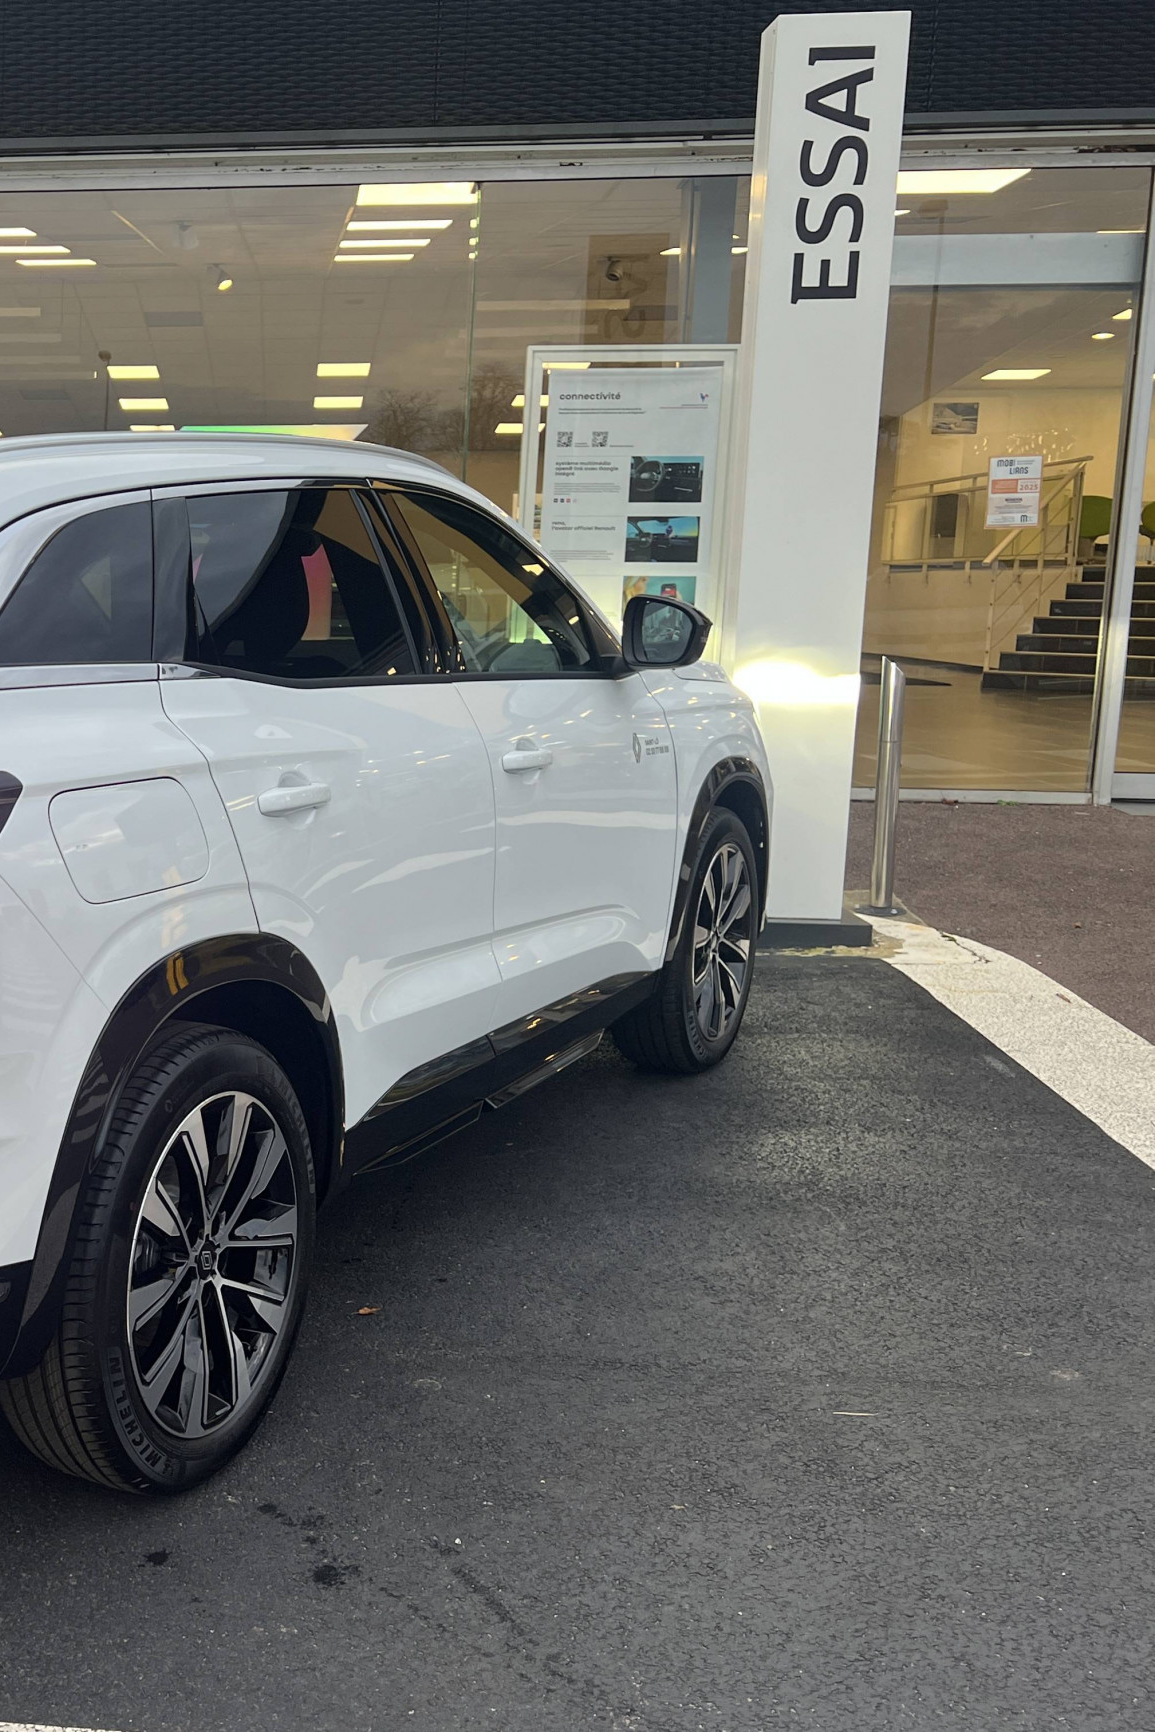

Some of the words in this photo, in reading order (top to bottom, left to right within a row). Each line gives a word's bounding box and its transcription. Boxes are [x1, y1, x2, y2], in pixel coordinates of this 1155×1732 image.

[791, 45, 876, 305] ESSAI
[559, 391, 621, 401] connectivité
[108, 1355, 164, 1468] MICHELIN
